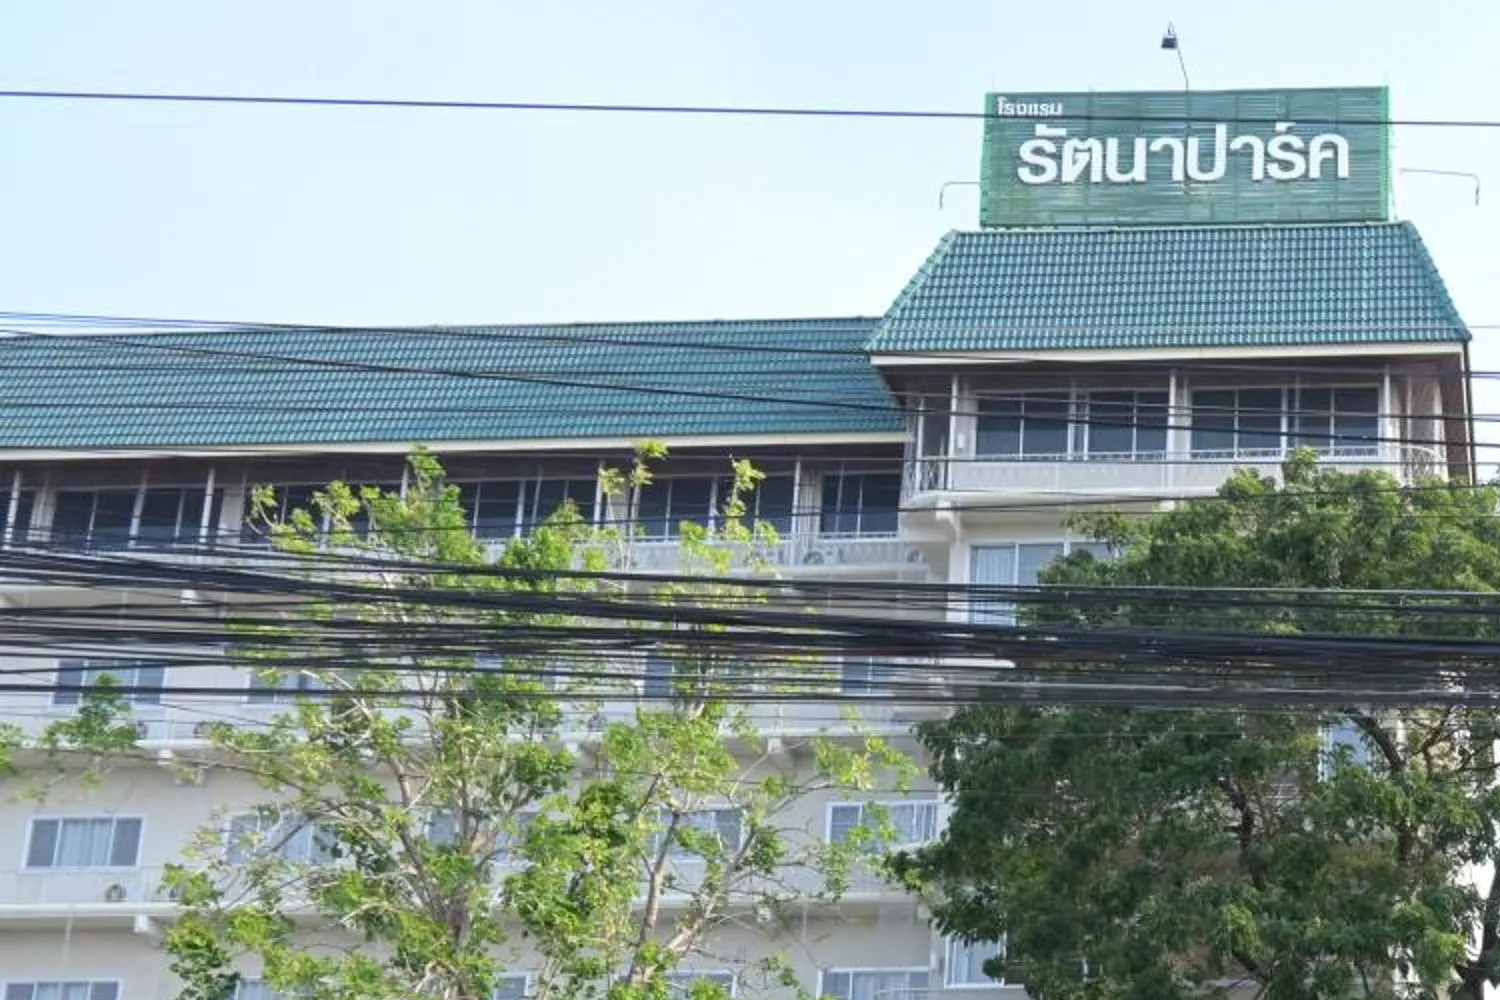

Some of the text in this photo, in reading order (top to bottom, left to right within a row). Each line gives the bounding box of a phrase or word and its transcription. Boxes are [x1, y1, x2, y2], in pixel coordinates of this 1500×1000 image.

[997, 96, 1063, 116] โรงแรม
[1017, 122, 1350, 184] รัตนาปาร์ค
